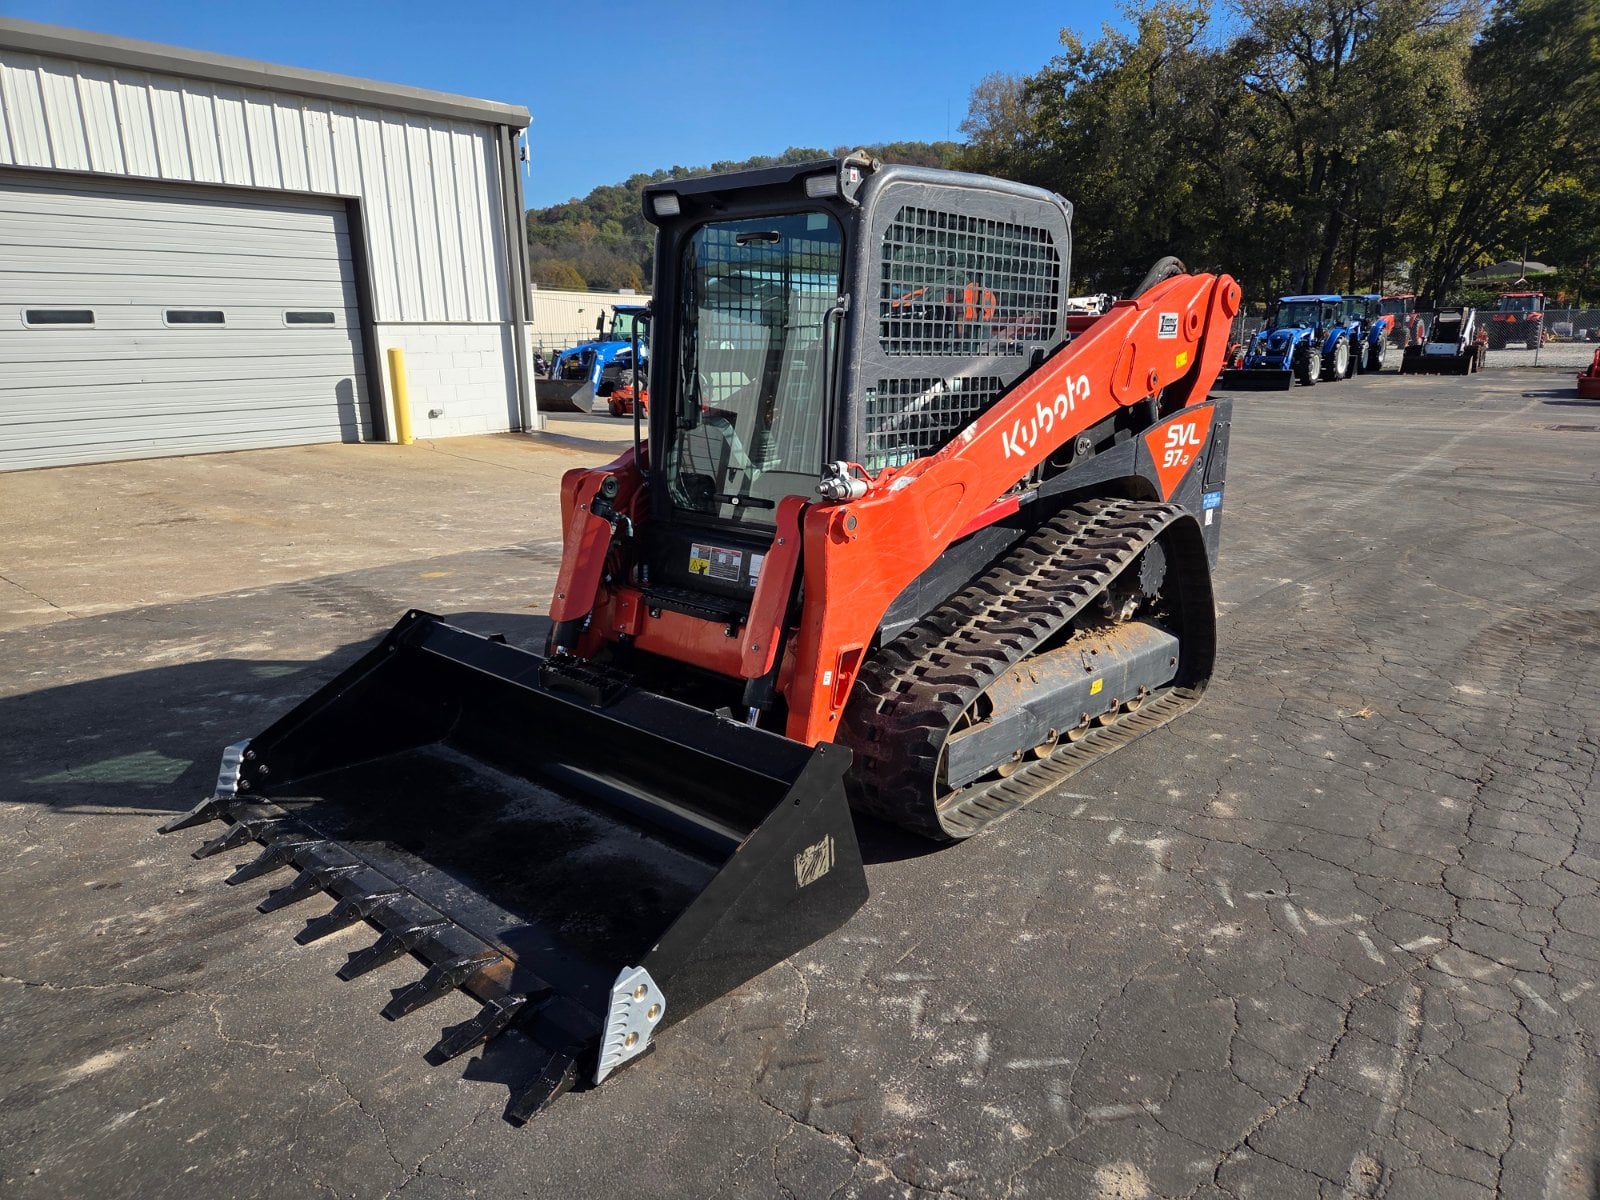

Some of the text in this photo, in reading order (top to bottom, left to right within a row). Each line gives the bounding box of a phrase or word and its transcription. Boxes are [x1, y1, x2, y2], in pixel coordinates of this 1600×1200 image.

[1001, 374, 1090, 459] Kubota
[1164, 422, 1200, 448] SVL
[1162, 449, 1189, 468] 97-2
